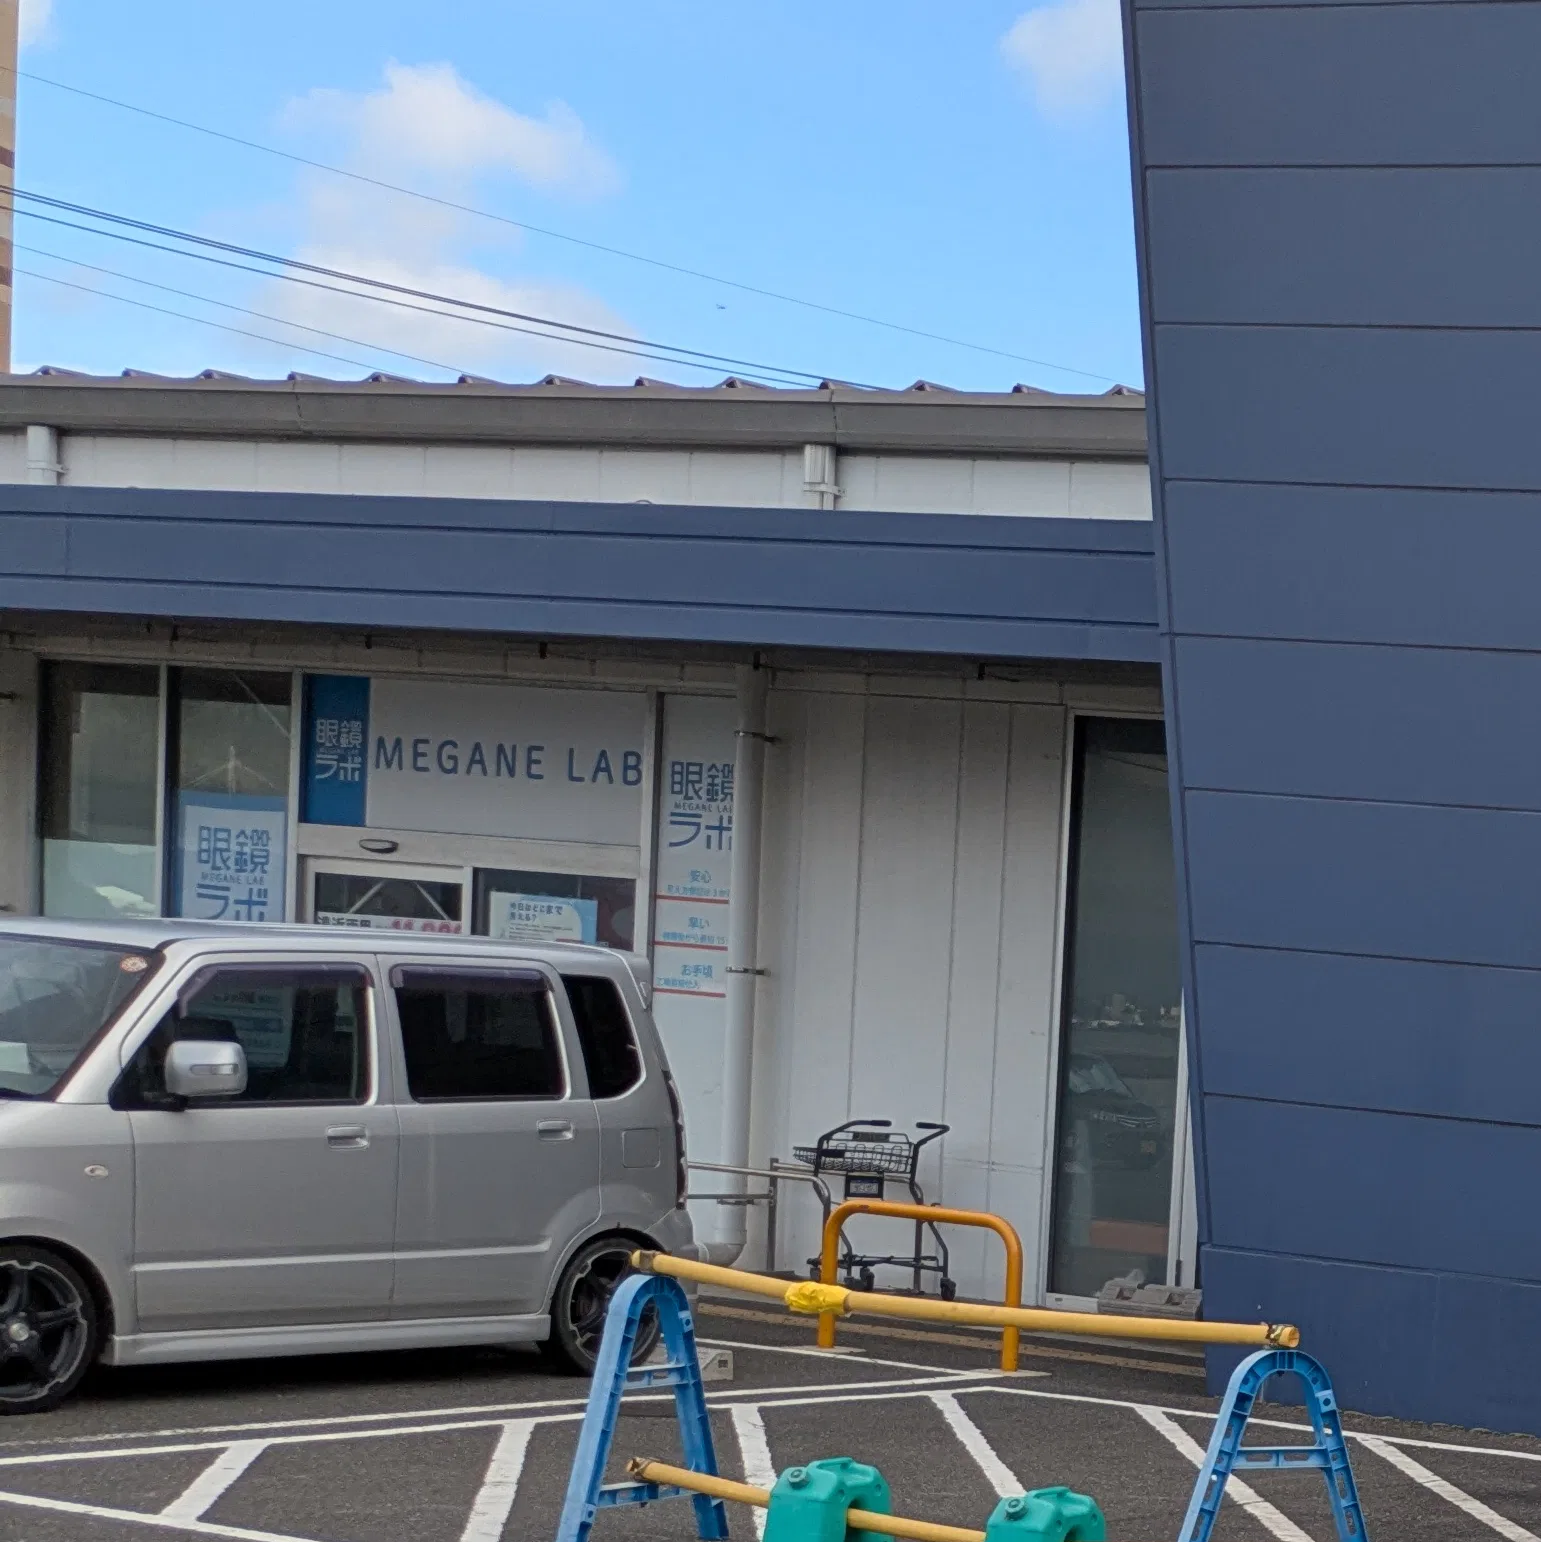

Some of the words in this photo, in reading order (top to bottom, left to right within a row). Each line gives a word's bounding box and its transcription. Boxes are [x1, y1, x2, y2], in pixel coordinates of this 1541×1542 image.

[315, 754, 362, 781] ラボ
[375, 736, 544, 780] MEGANE
[568, 747, 643, 786] LAB
[201, 871, 244, 885] MEGANE
[196, 884, 269, 921] ラボ
